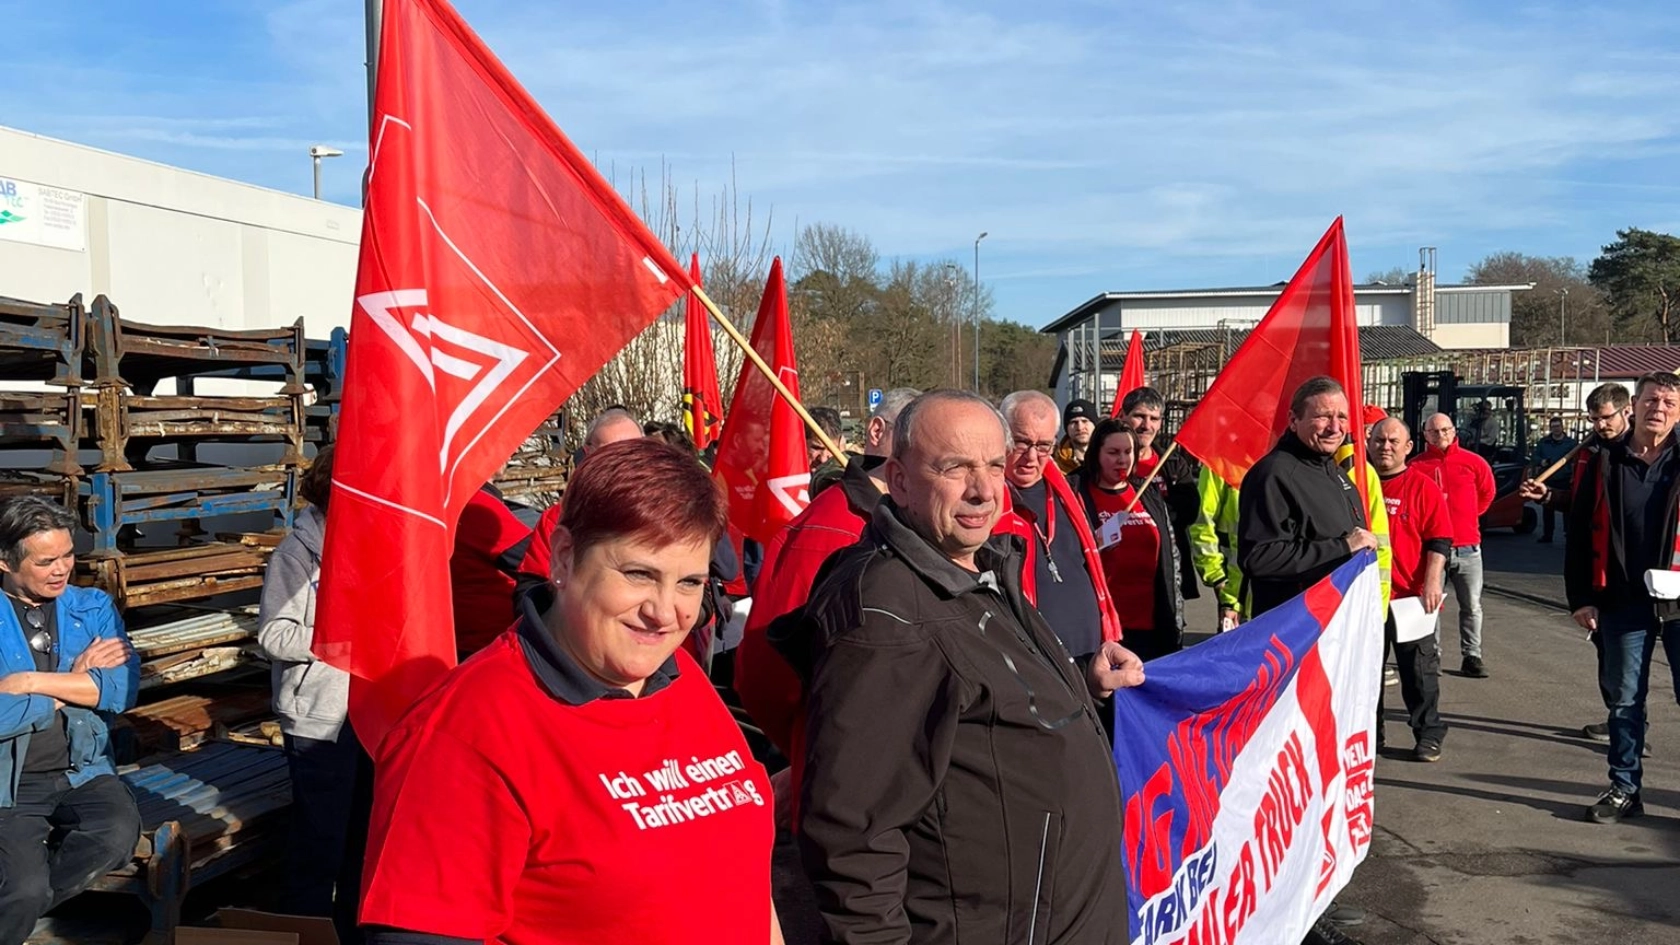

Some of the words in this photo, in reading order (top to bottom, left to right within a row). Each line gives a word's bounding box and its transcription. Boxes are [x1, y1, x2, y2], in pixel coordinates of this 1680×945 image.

[872, 391, 880, 403] P
[598, 771, 647, 800] Ich
[643, 758, 690, 793] will
[685, 749, 746, 784] einen
[1254, 729, 1313, 894] TRUCK
[1123, 761, 1175, 899] IG
[1138, 872, 1188, 945] ARK
[1187, 840, 1217, 912] BEI
